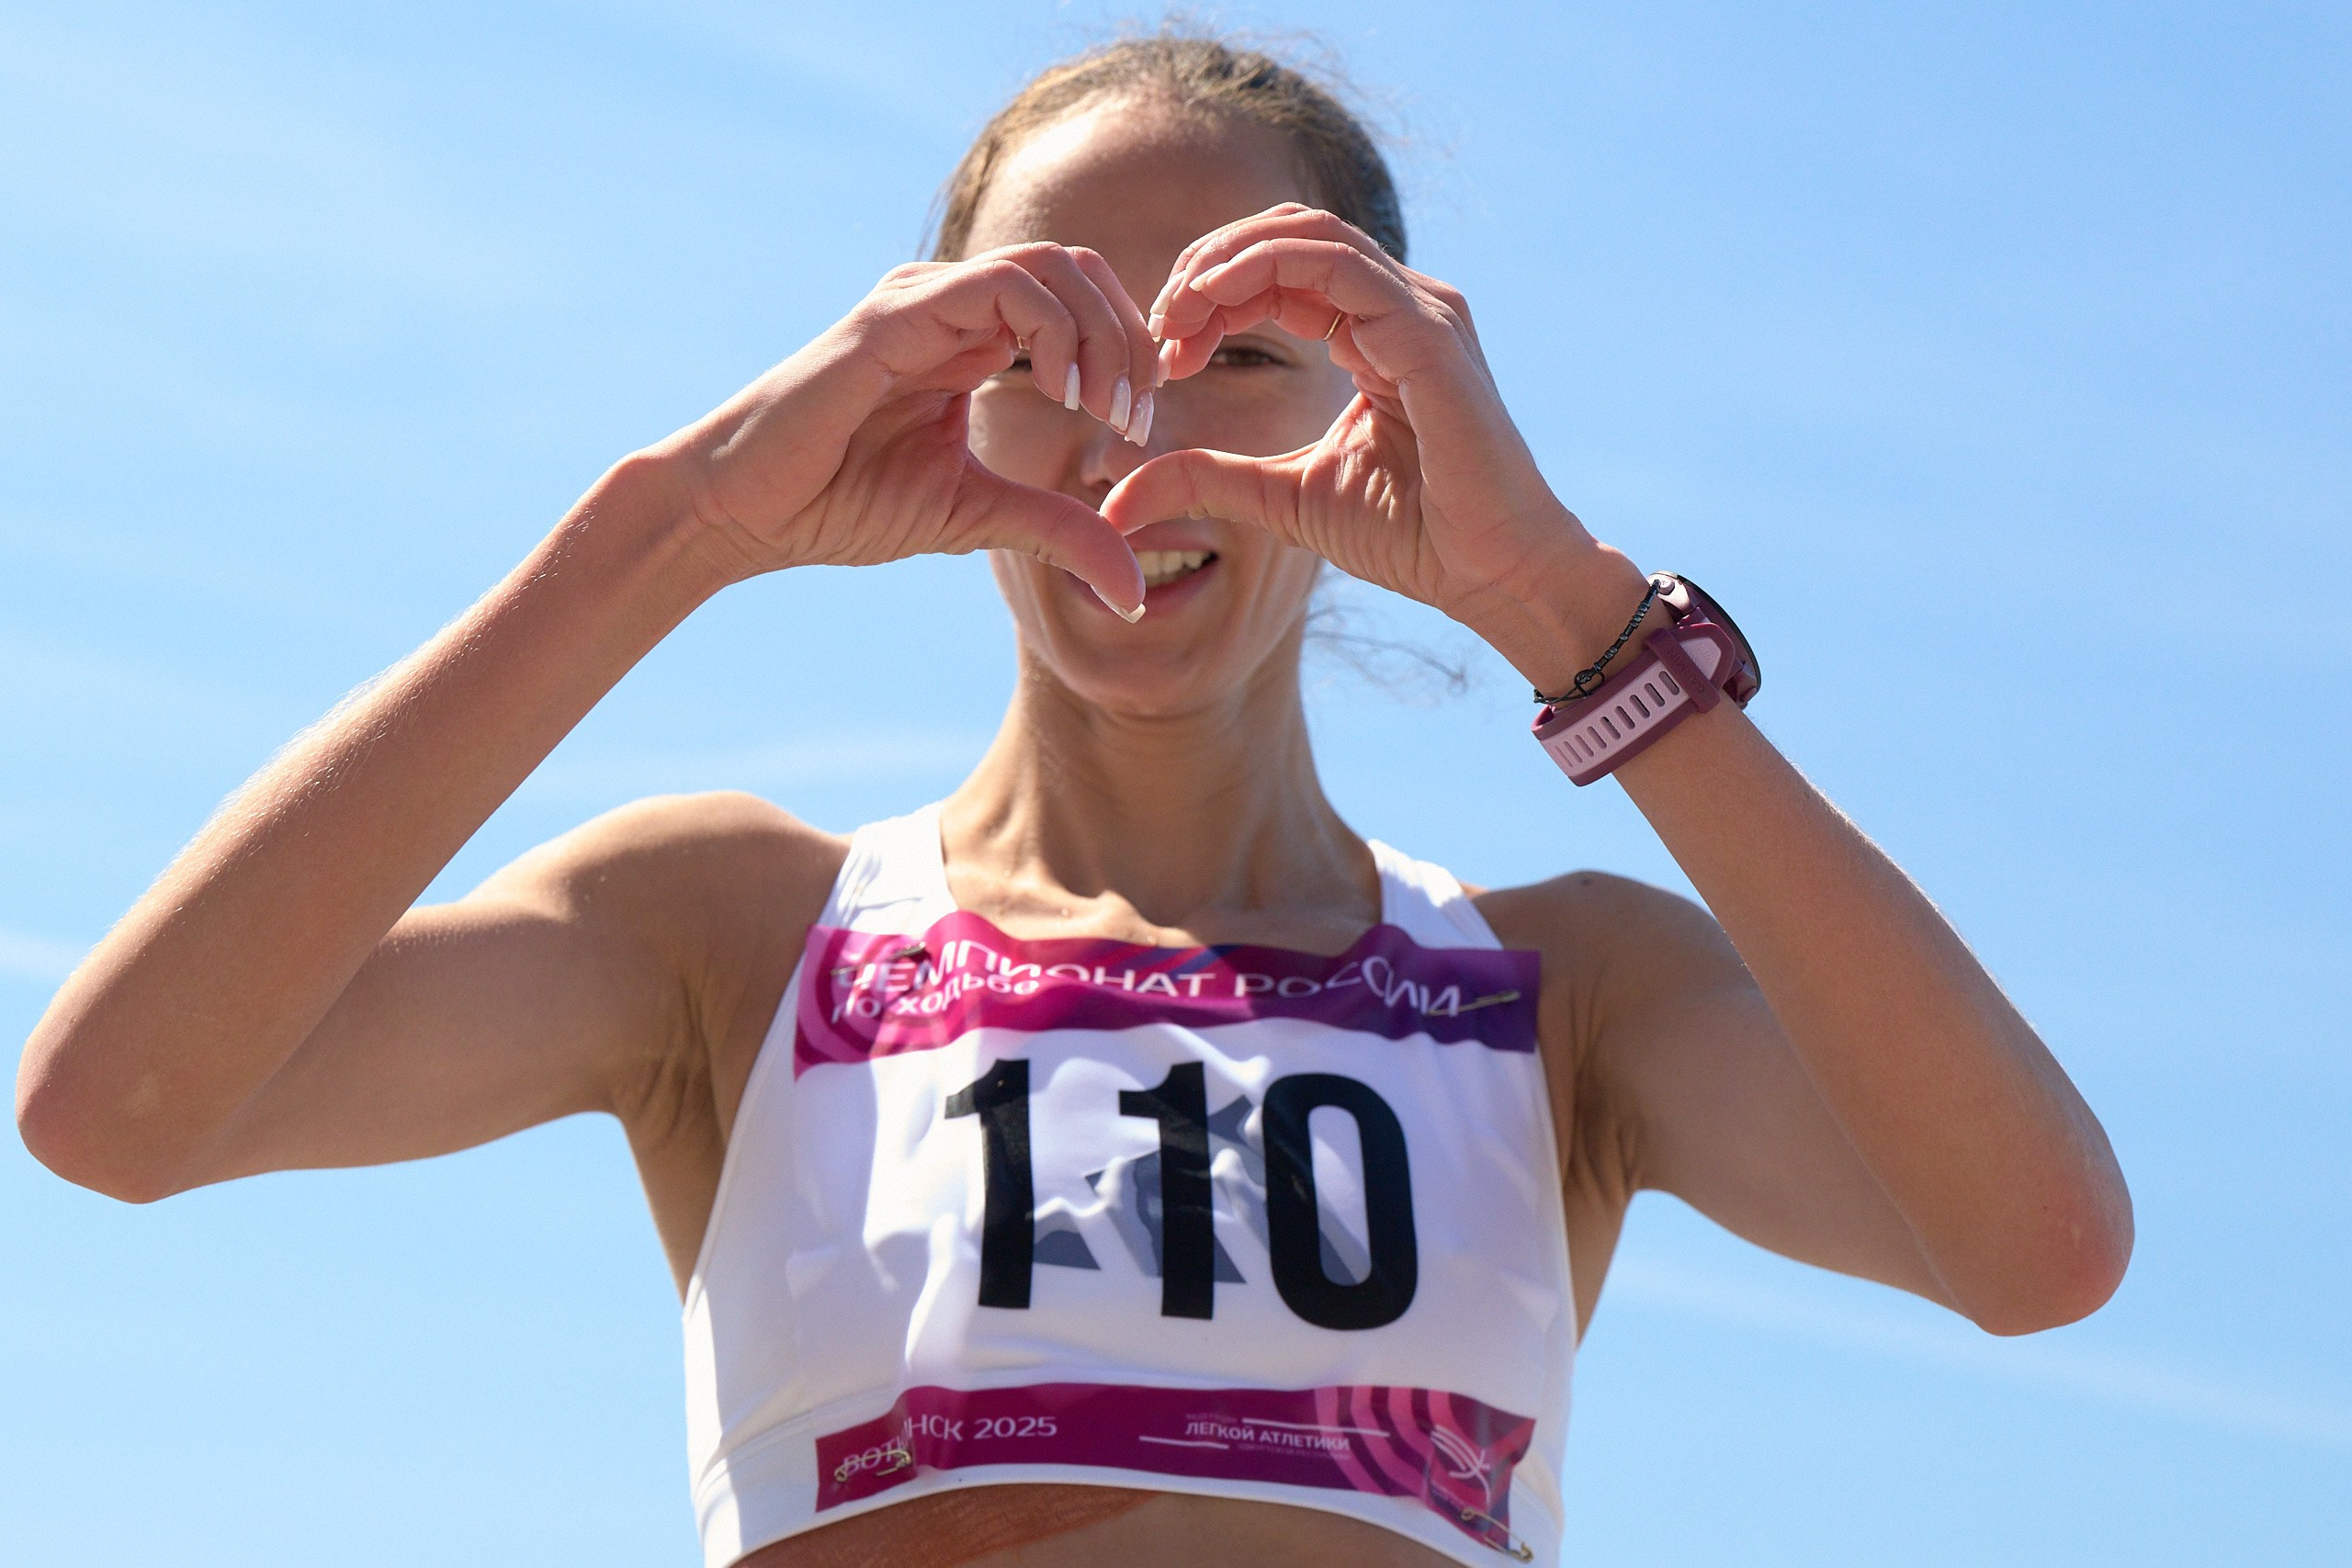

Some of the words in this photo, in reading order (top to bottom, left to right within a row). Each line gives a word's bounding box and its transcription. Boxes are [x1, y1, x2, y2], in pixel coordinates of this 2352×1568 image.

[836, 939, 1215, 998] ЧЕМПИОНАТ
[944, 1058, 1419, 1332] 110
[974, 1416, 1058, 1439] 2025
[1184, 1420, 1255, 1441] ЛЕГКОЙ
[1259, 1429, 1351, 1451] АТЛЕТИКИ
